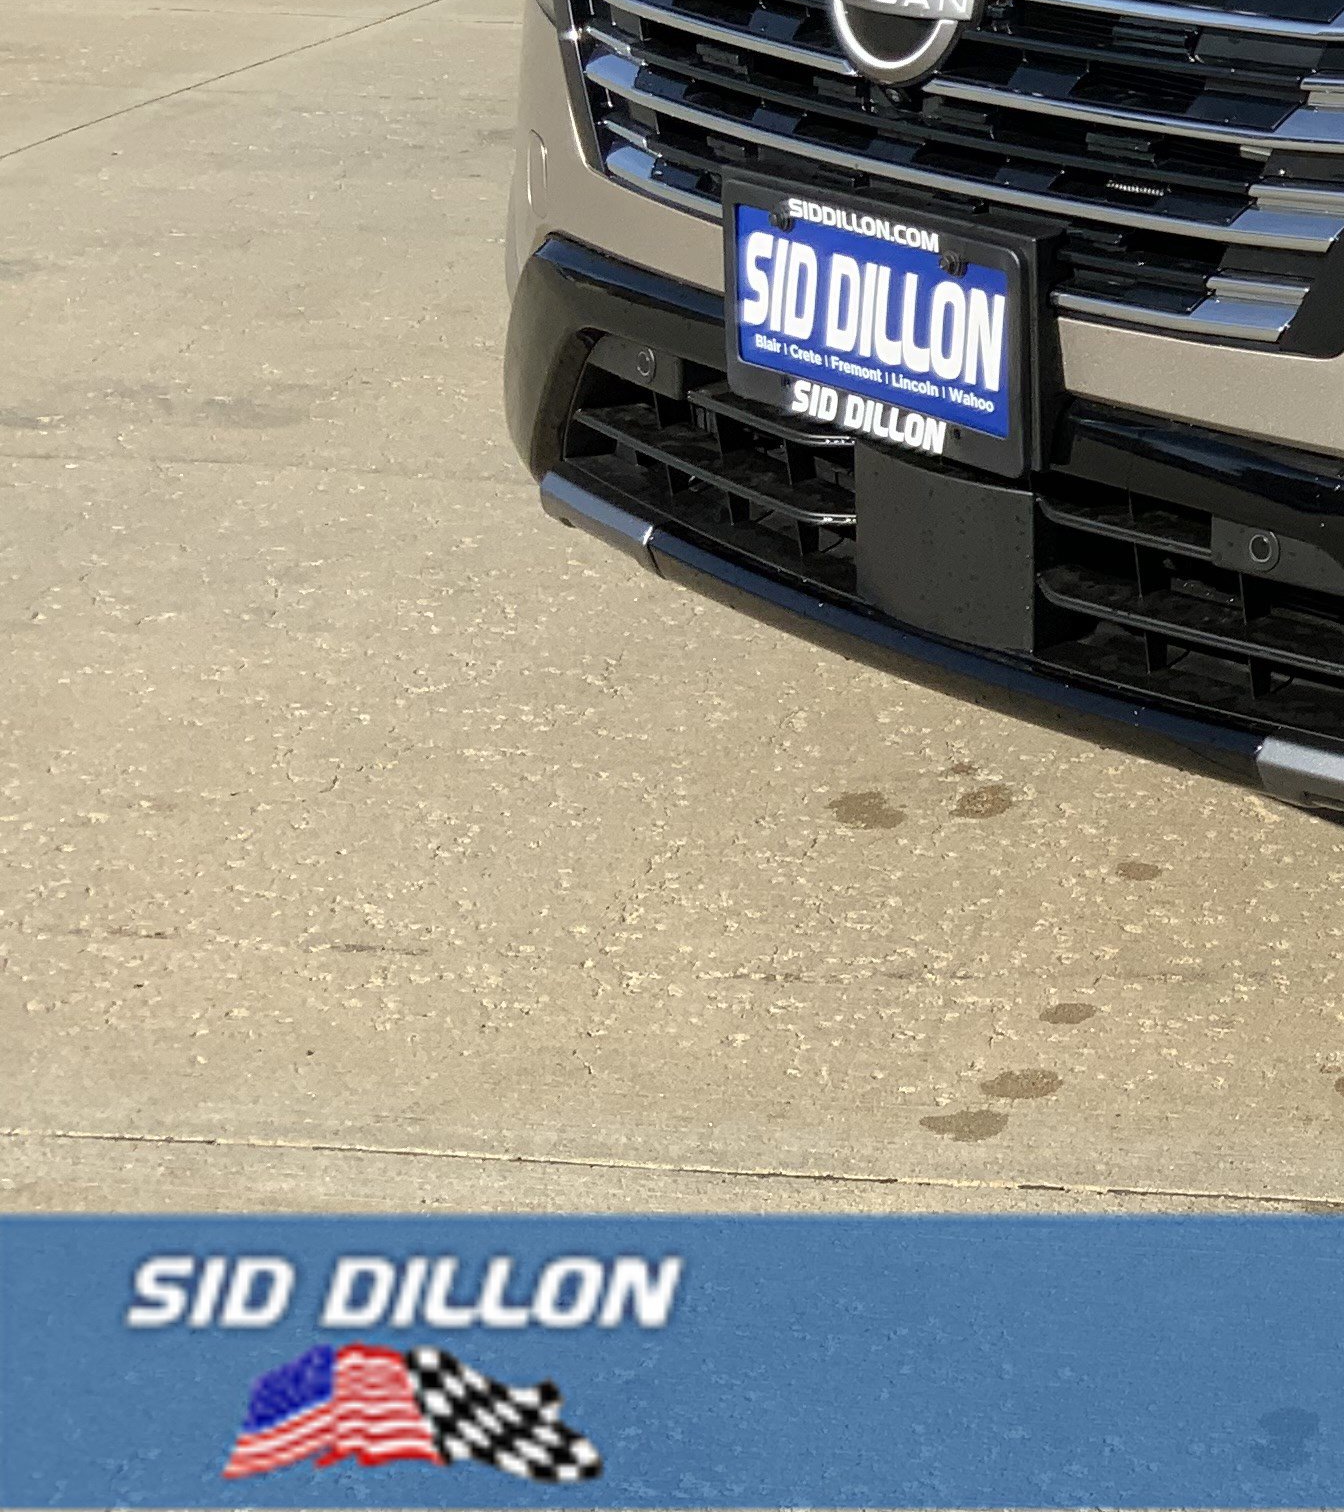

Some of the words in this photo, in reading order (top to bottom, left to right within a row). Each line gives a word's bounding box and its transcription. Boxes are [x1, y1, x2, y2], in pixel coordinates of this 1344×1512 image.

[788, 198, 940, 254] SIDDILLON.COM
[743, 231, 818, 340] SID
[826, 253, 1006, 392] DILLON
[755, 334, 781, 354] Blair
[790, 343, 822, 366] Crete
[831, 355, 883, 385] Fremont
[891, 372, 939, 399] Lincoln
[949, 386, 994, 413] Wahoo
[791, 380, 838, 422] SID
[844, 393, 947, 455] DILLON
